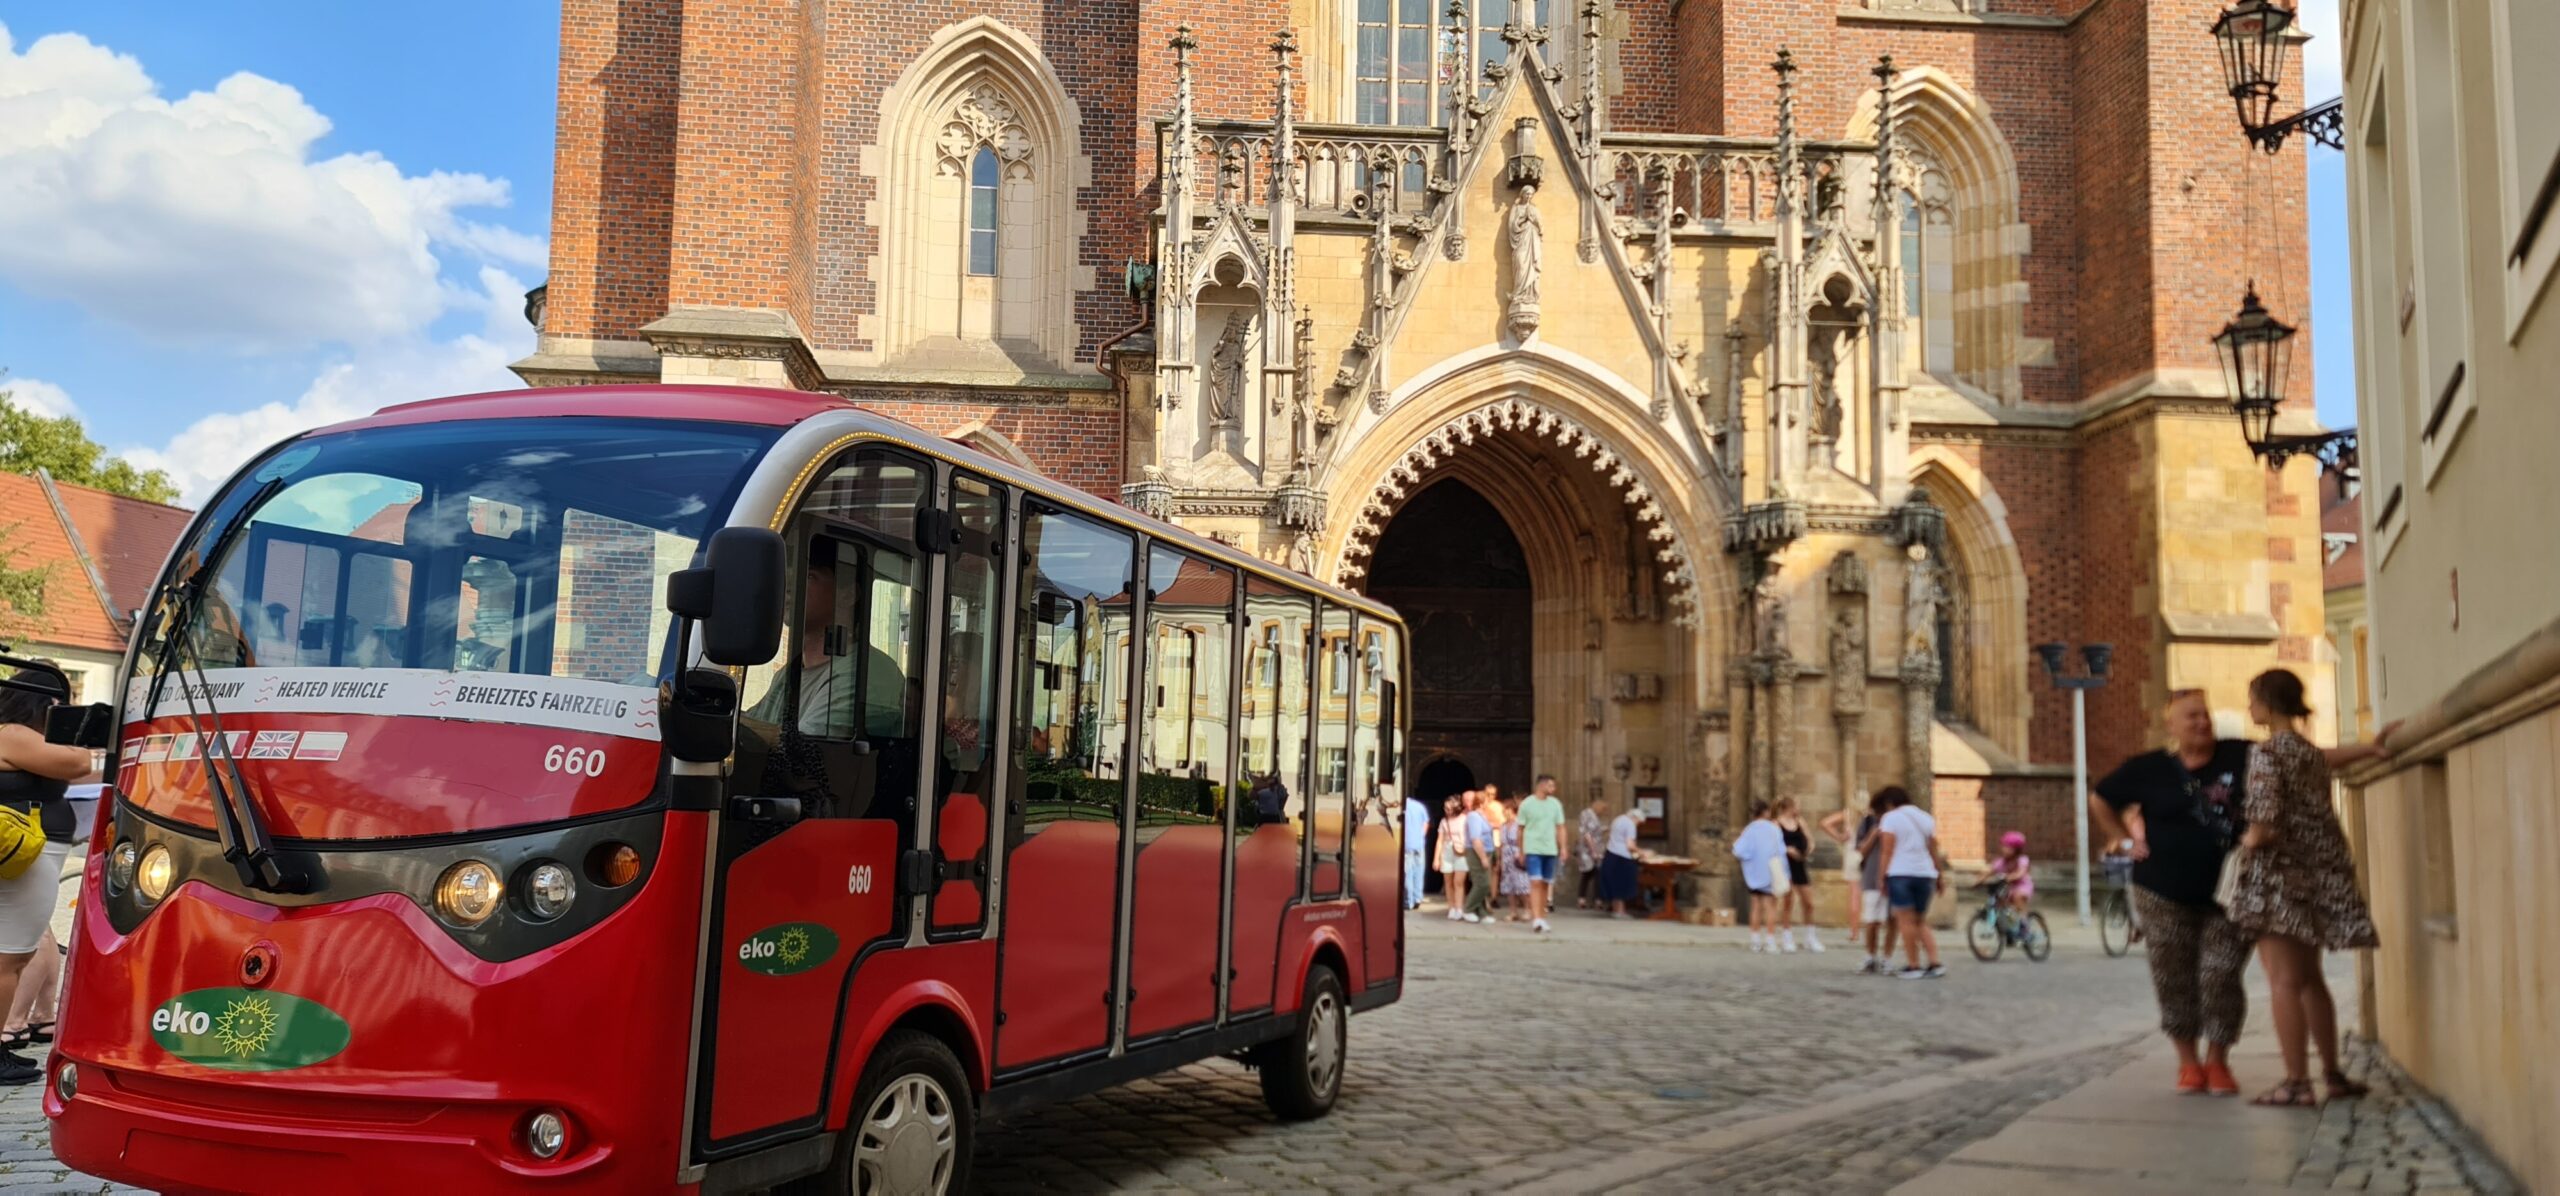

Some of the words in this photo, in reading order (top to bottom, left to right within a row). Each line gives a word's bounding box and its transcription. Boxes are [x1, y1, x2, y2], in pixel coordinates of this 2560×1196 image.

[276, 682, 328, 698] HEATED
[331, 682, 389, 699] VEHICLE
[455, 685, 537, 708] BEHEIZTES
[540, 692, 627, 718] FAHRZEUG
[544, 745, 606, 777] 660
[849, 865, 871, 893] 660
[739, 937, 775, 959] eko
[152, 1002, 210, 1035] eko
